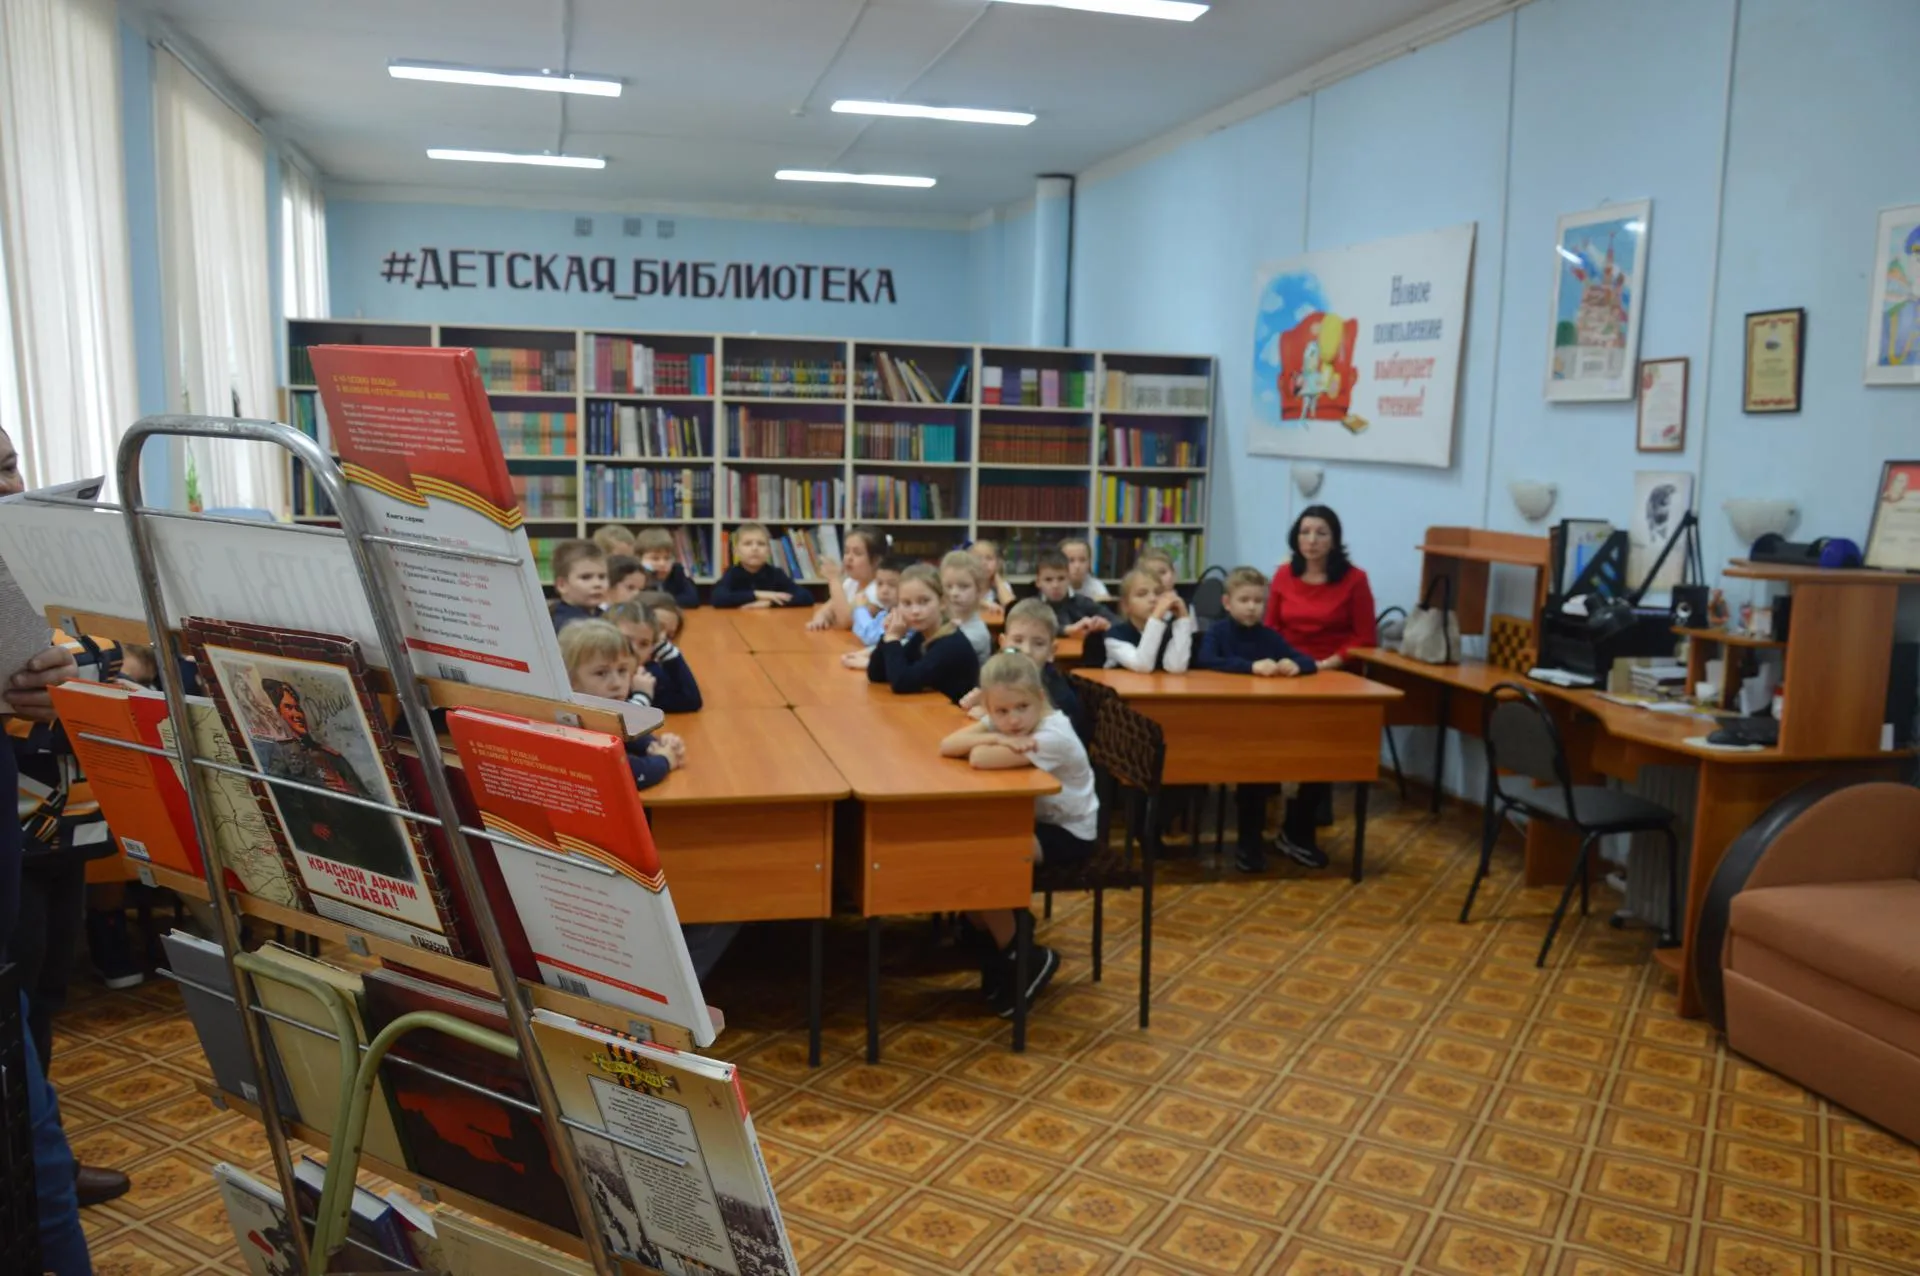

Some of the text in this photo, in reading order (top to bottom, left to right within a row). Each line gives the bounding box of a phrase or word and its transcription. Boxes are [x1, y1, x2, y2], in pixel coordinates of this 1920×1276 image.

[381, 247, 897, 304] #ДЕТСКАЯ_БИБЛИОТЕКА
[1390, 275, 1431, 306] Новое
[308, 856, 418, 900] КРАСНОЙ АРМИИ
